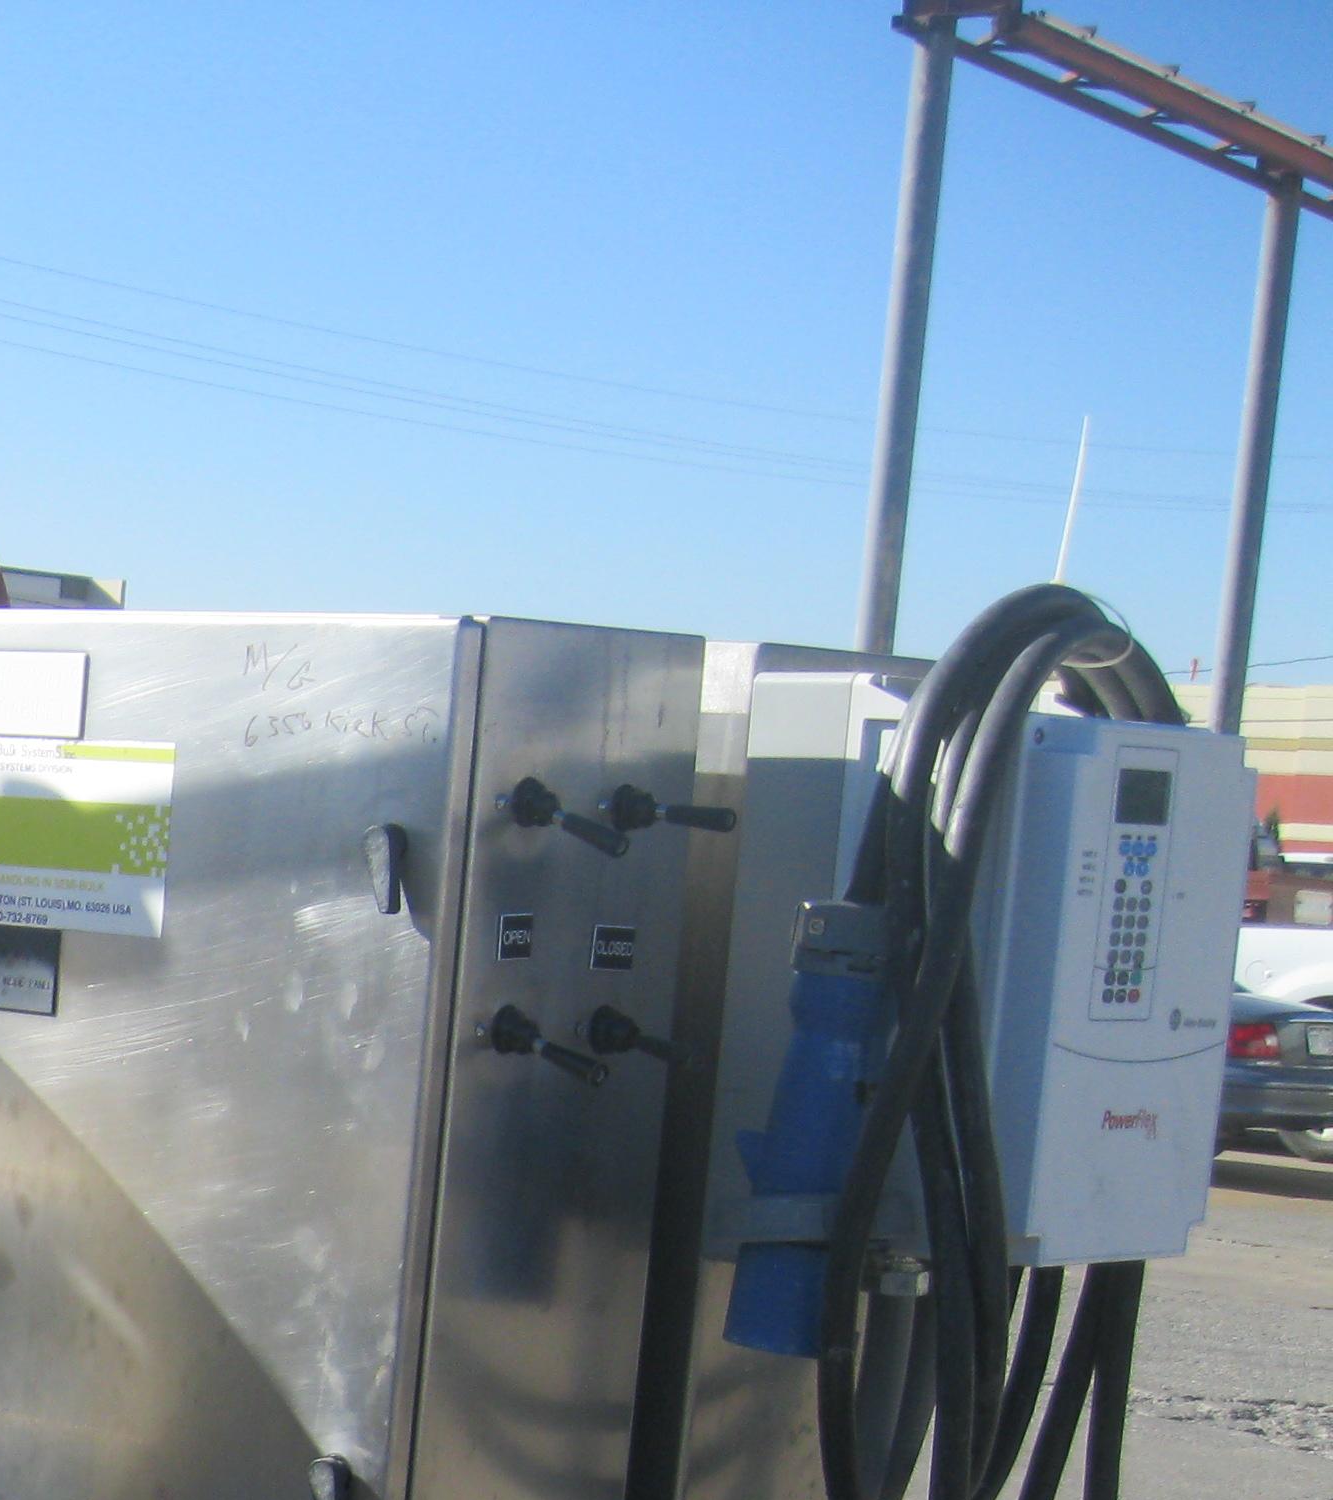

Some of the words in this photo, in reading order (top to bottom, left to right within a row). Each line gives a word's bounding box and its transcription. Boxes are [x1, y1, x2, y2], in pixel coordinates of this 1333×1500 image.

[0, 761, 37, 773] SYSTEMS
[113, 904, 132, 916] USA
[503, 930, 531, 945] OPEN
[595, 940, 633, 957] CLOSED
